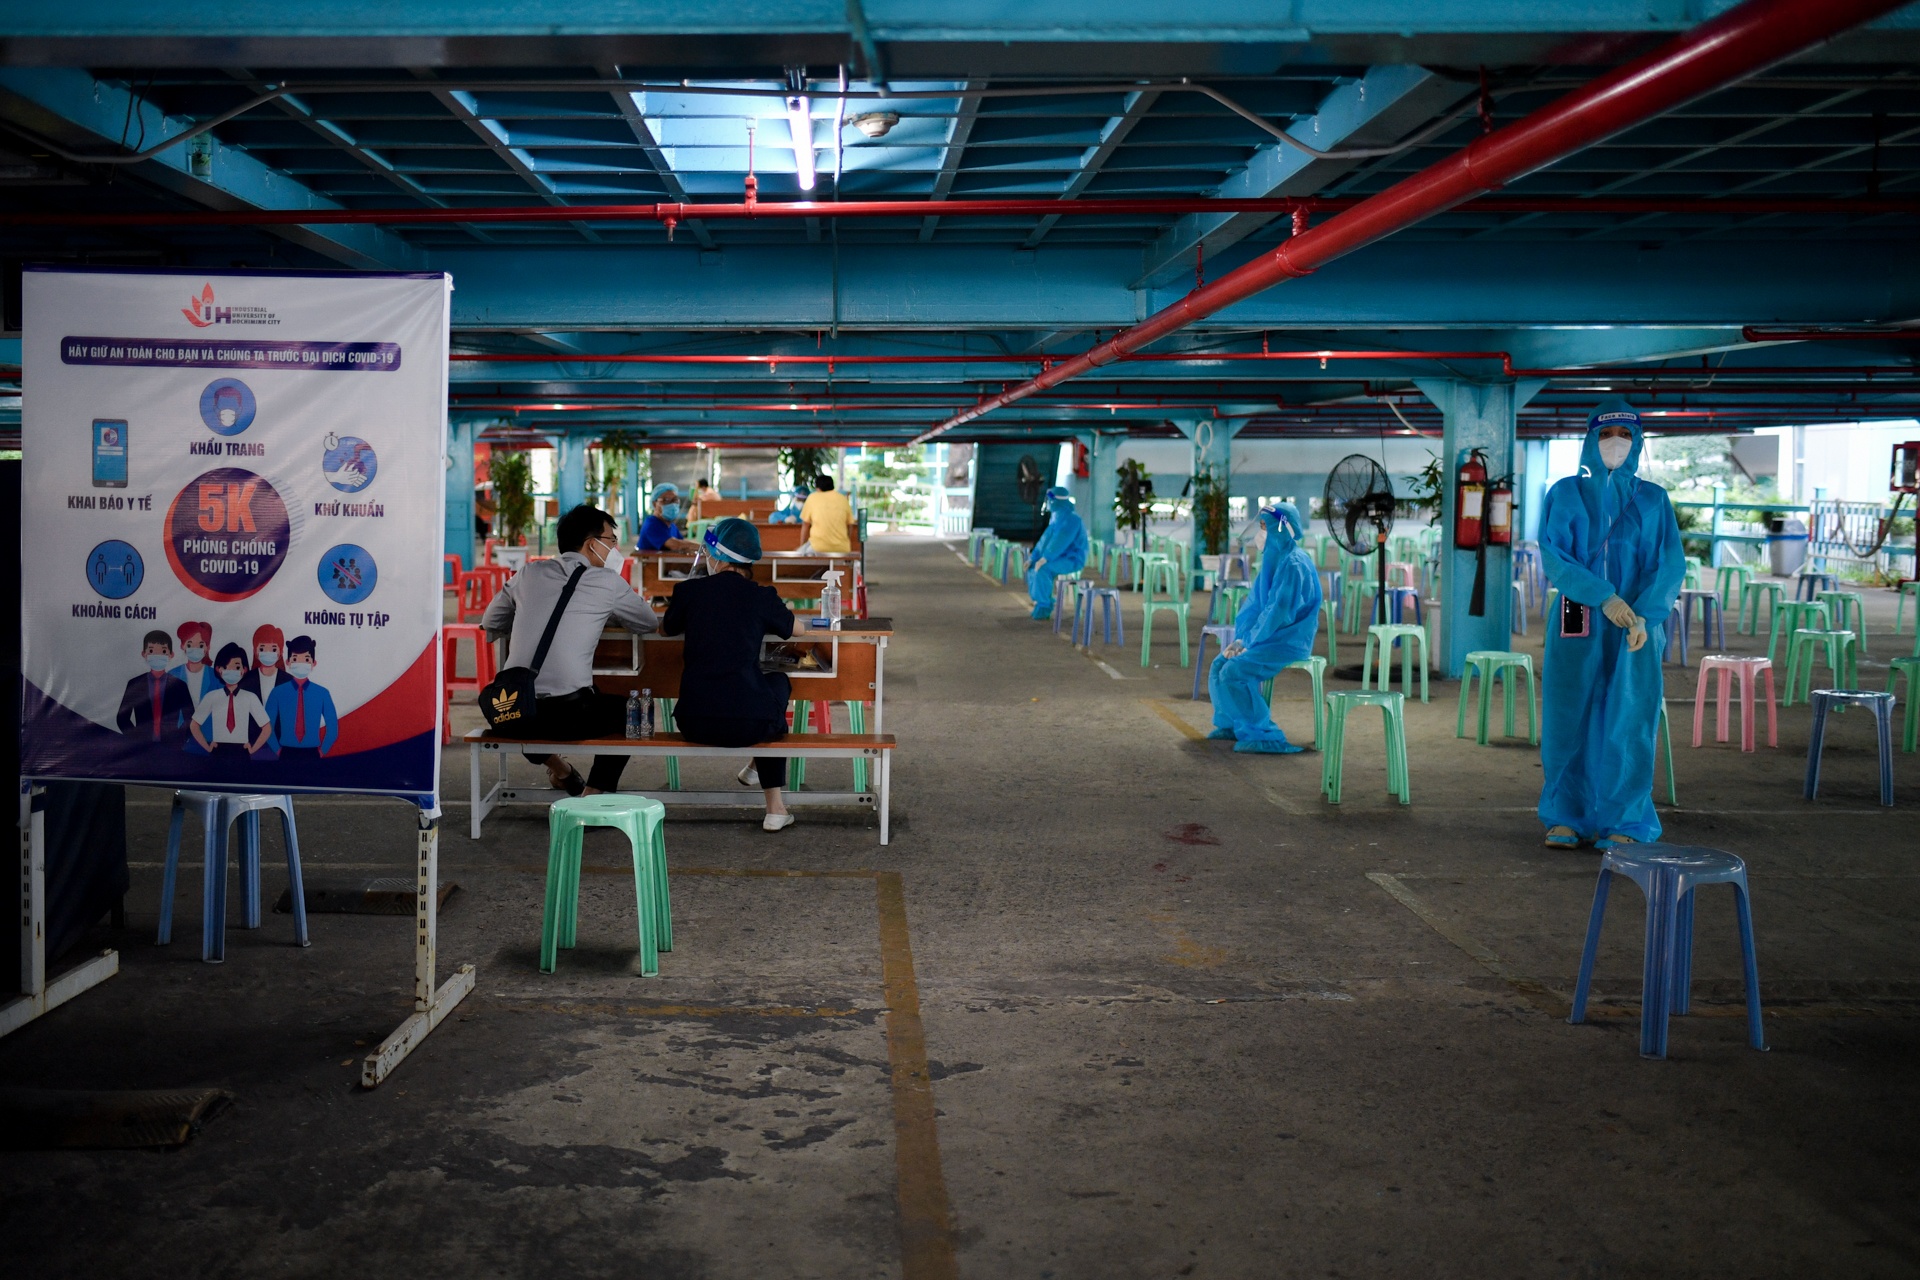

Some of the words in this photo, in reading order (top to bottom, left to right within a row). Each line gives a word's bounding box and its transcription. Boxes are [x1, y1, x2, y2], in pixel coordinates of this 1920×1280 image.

[68, 344, 87, 357] HÃY
[90, 346, 108, 358] GIỮ
[110, 347, 123, 358] AN
[127, 346, 152, 359] TOÀN
[155, 348, 175, 360] CHO
[178, 348, 198, 362] BẠN
[202, 347, 214, 360] VÀ
[217, 348, 250, 361] CHÚNG
[254, 350, 265, 361] TA
[267, 348, 299, 362] TRƯỚC
[302, 351, 319, 365] ĐẠI
[322, 352, 345, 365] DỊCH
[348, 352, 394, 363] COVID-19
[190, 437, 222, 455] KHẨU
[226, 442, 265, 456] TRANG
[67, 495, 95, 510] KHAI
[100, 494, 124, 511] BÁO
[127, 498, 135, 510] Y
[138, 494, 152, 511] TẾ
[198, 483, 257, 532] 5K
[315, 499, 341, 517] KHỬ
[343, 499, 384, 517] KHUẨN
[183, 536, 228, 554] PHÒNG
[231, 536, 276, 555] CHỐNG
[200, 559, 259, 574] COVID-19
[72, 601, 121, 619] KHOẢNG
[124, 604, 156, 619] CÁCH
[304, 609, 346, 625] KHÔNG
[349, 613, 364, 629] TỤ
[367, 611, 390, 629] TẬP
[494, 711, 521, 724] adidas
